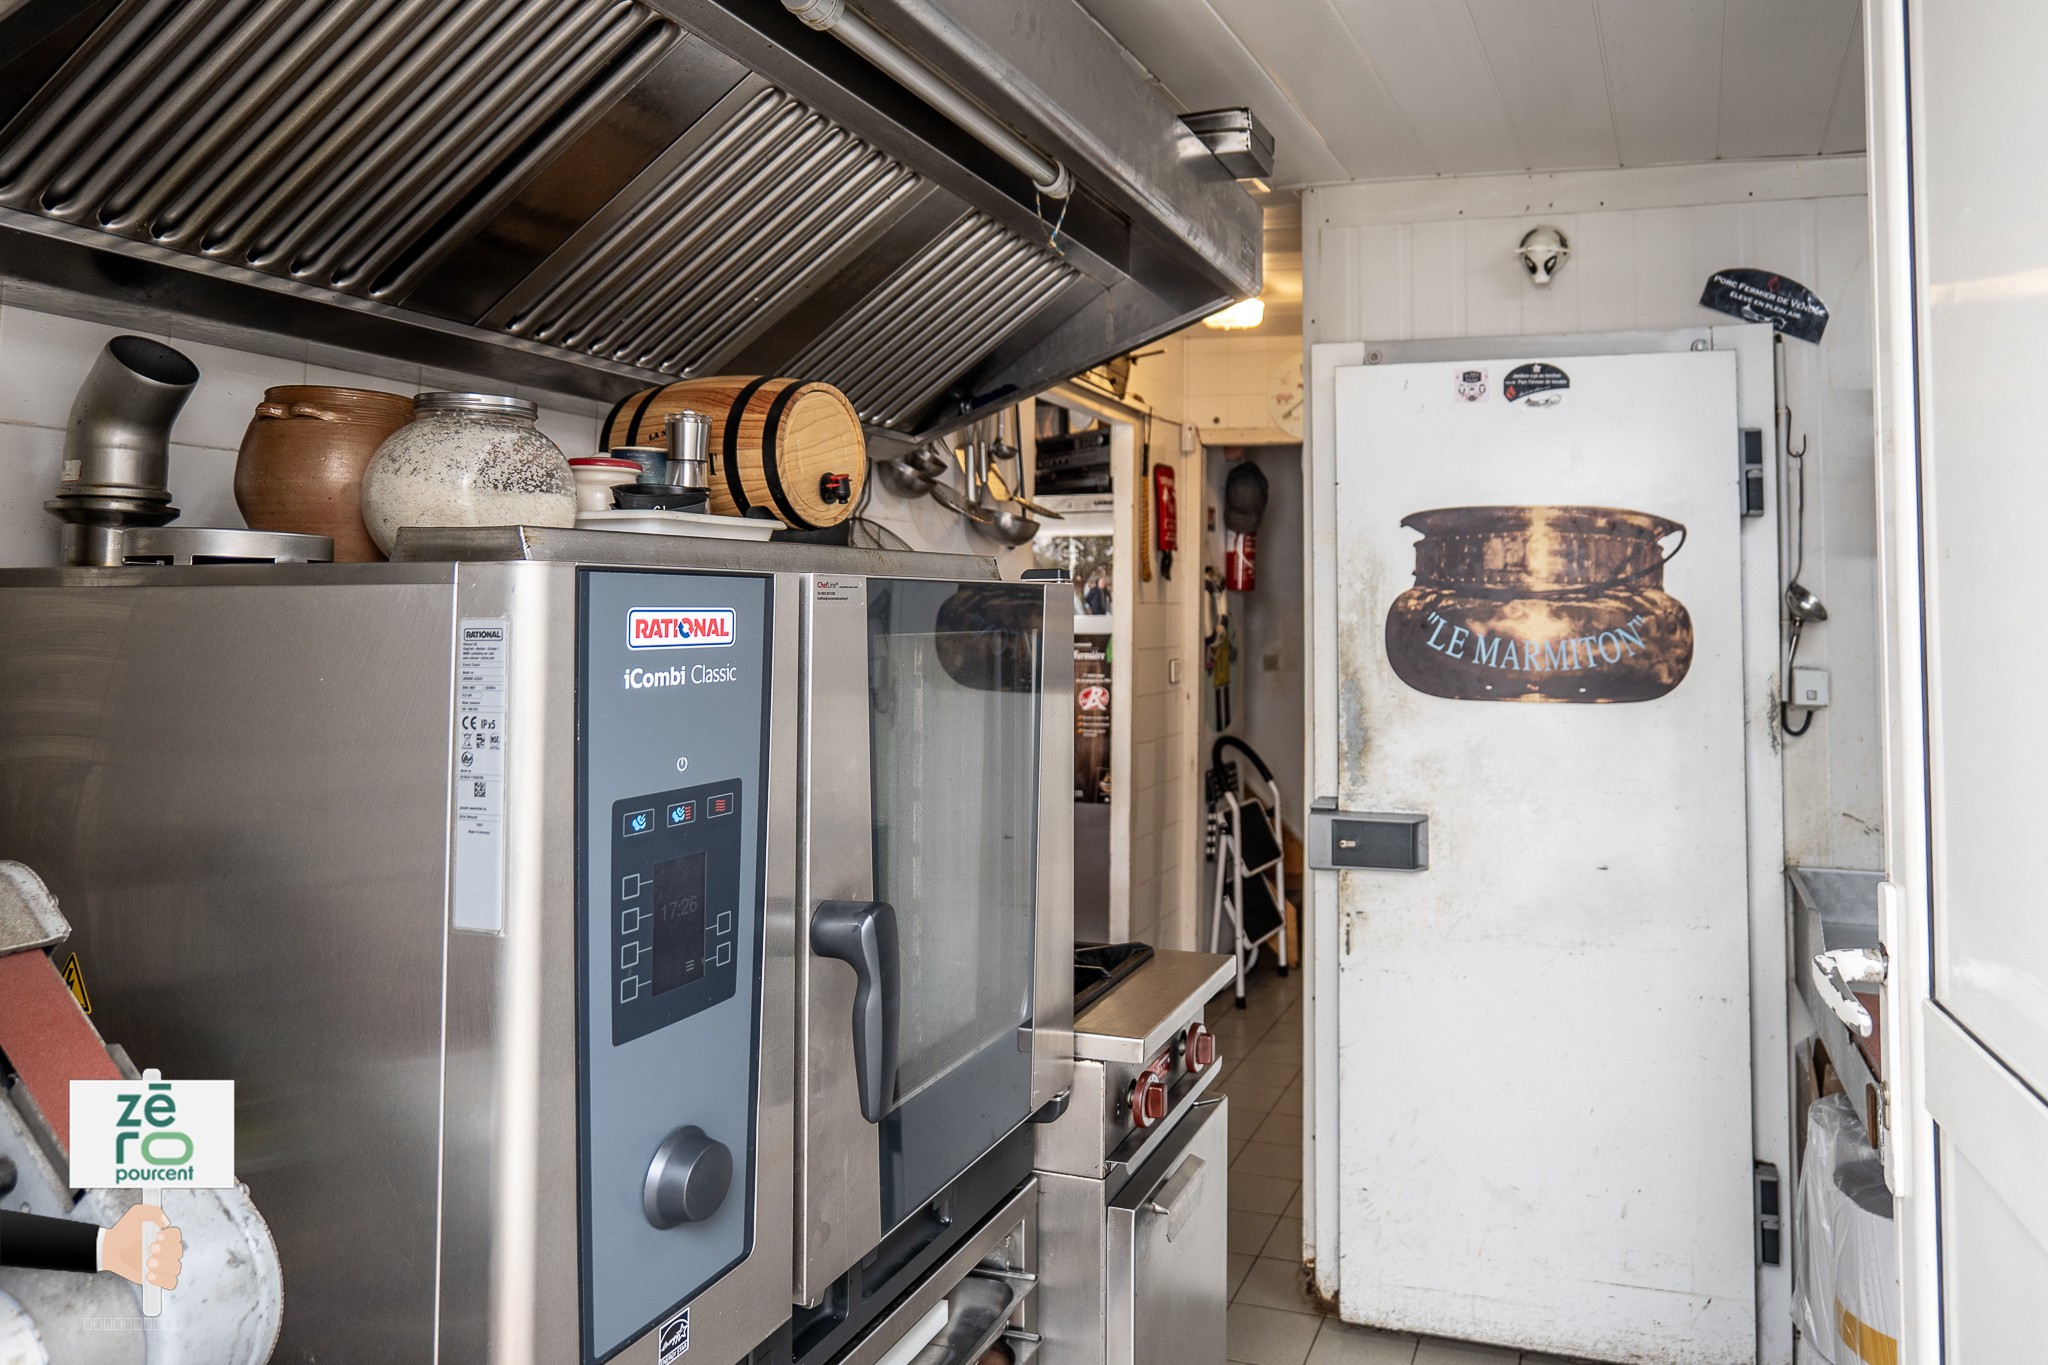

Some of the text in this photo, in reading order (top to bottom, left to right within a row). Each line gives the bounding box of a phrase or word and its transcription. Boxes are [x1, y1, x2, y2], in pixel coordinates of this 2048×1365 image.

[1713, 275, 1738, 288] PORC
[1738, 283, 1776, 301] FERMIER
[1777, 295, 1789, 306] DE
[1753, 299, 1765, 307] EN
[1764, 302, 1787, 315] PLEIN
[465, 630, 501, 639] RATIONAL
[635, 617, 729, 639] RATIONAL
[624, 662, 737, 690] iCombi Classic
[661, 895, 698, 922] 17:26
